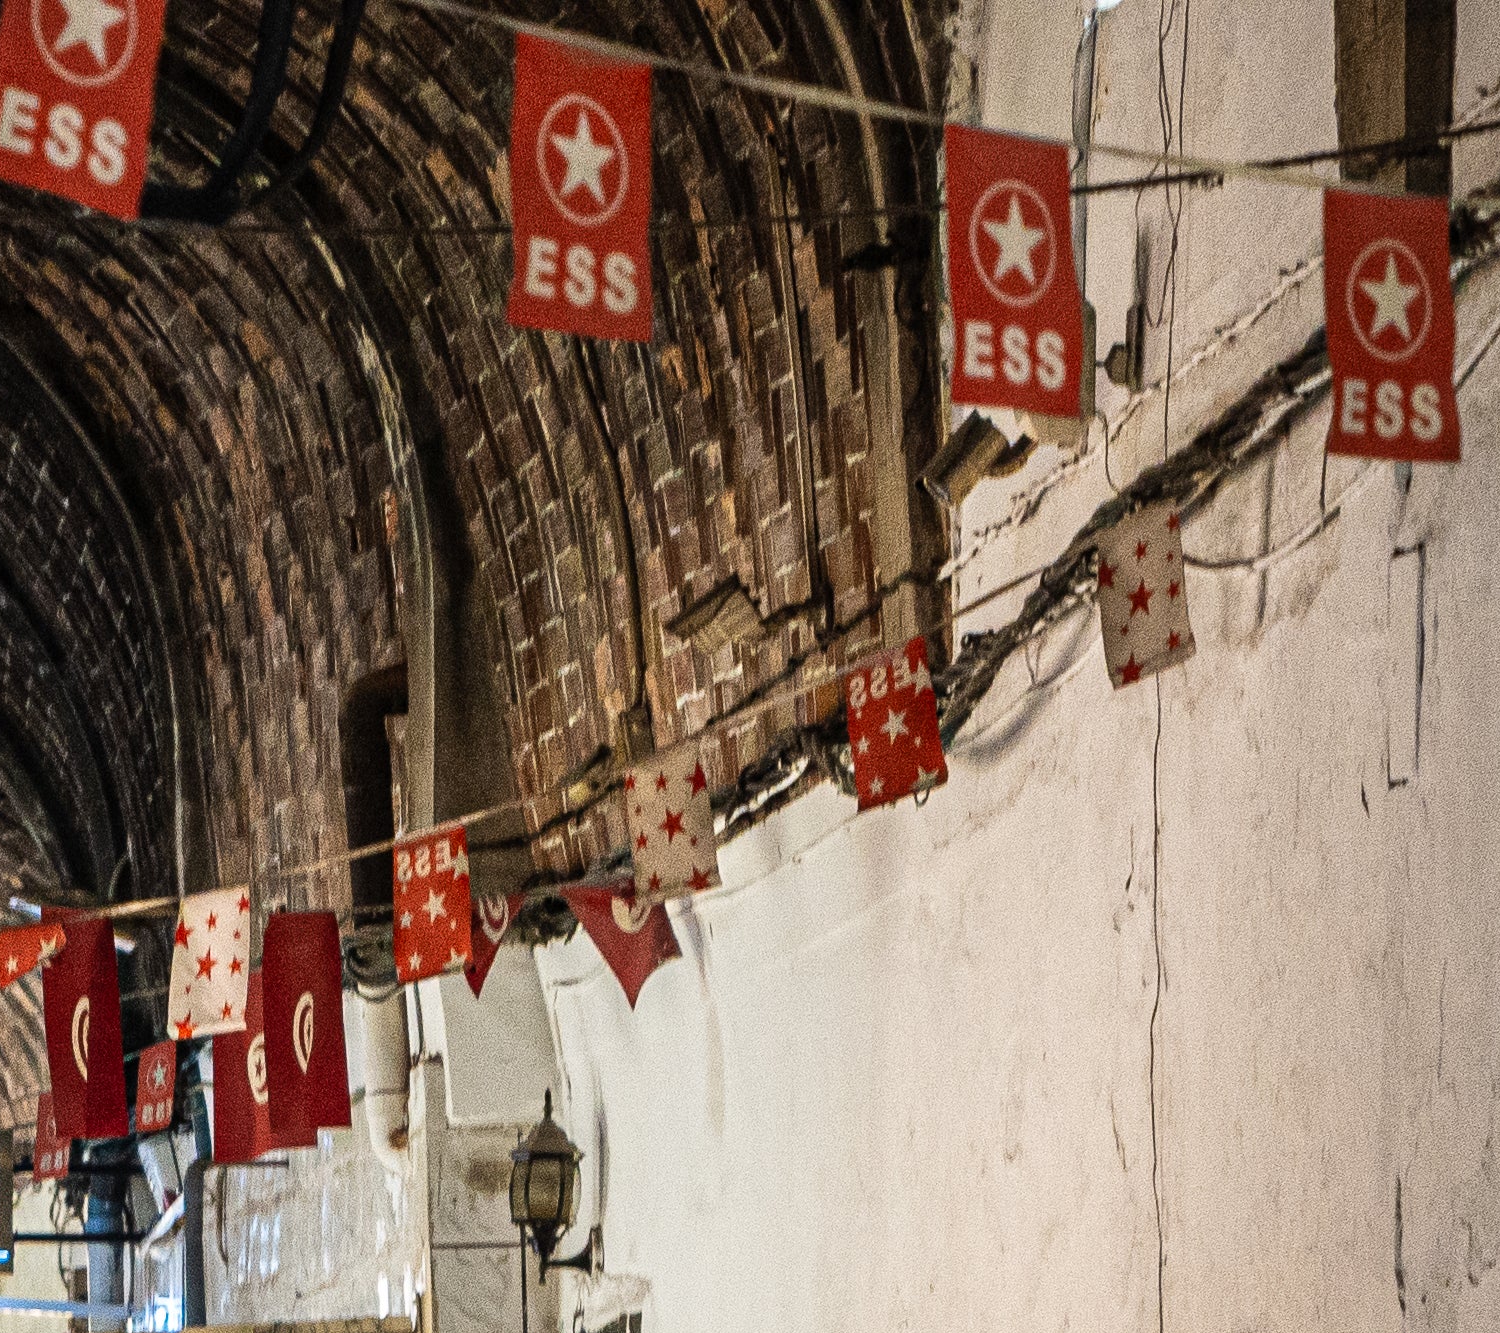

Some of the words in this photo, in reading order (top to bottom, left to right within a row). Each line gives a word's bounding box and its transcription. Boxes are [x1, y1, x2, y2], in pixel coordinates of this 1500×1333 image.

[525, 237, 639, 314] ESS
[962, 318, 1068, 390] ESS
[1340, 380, 1445, 440] ESS
